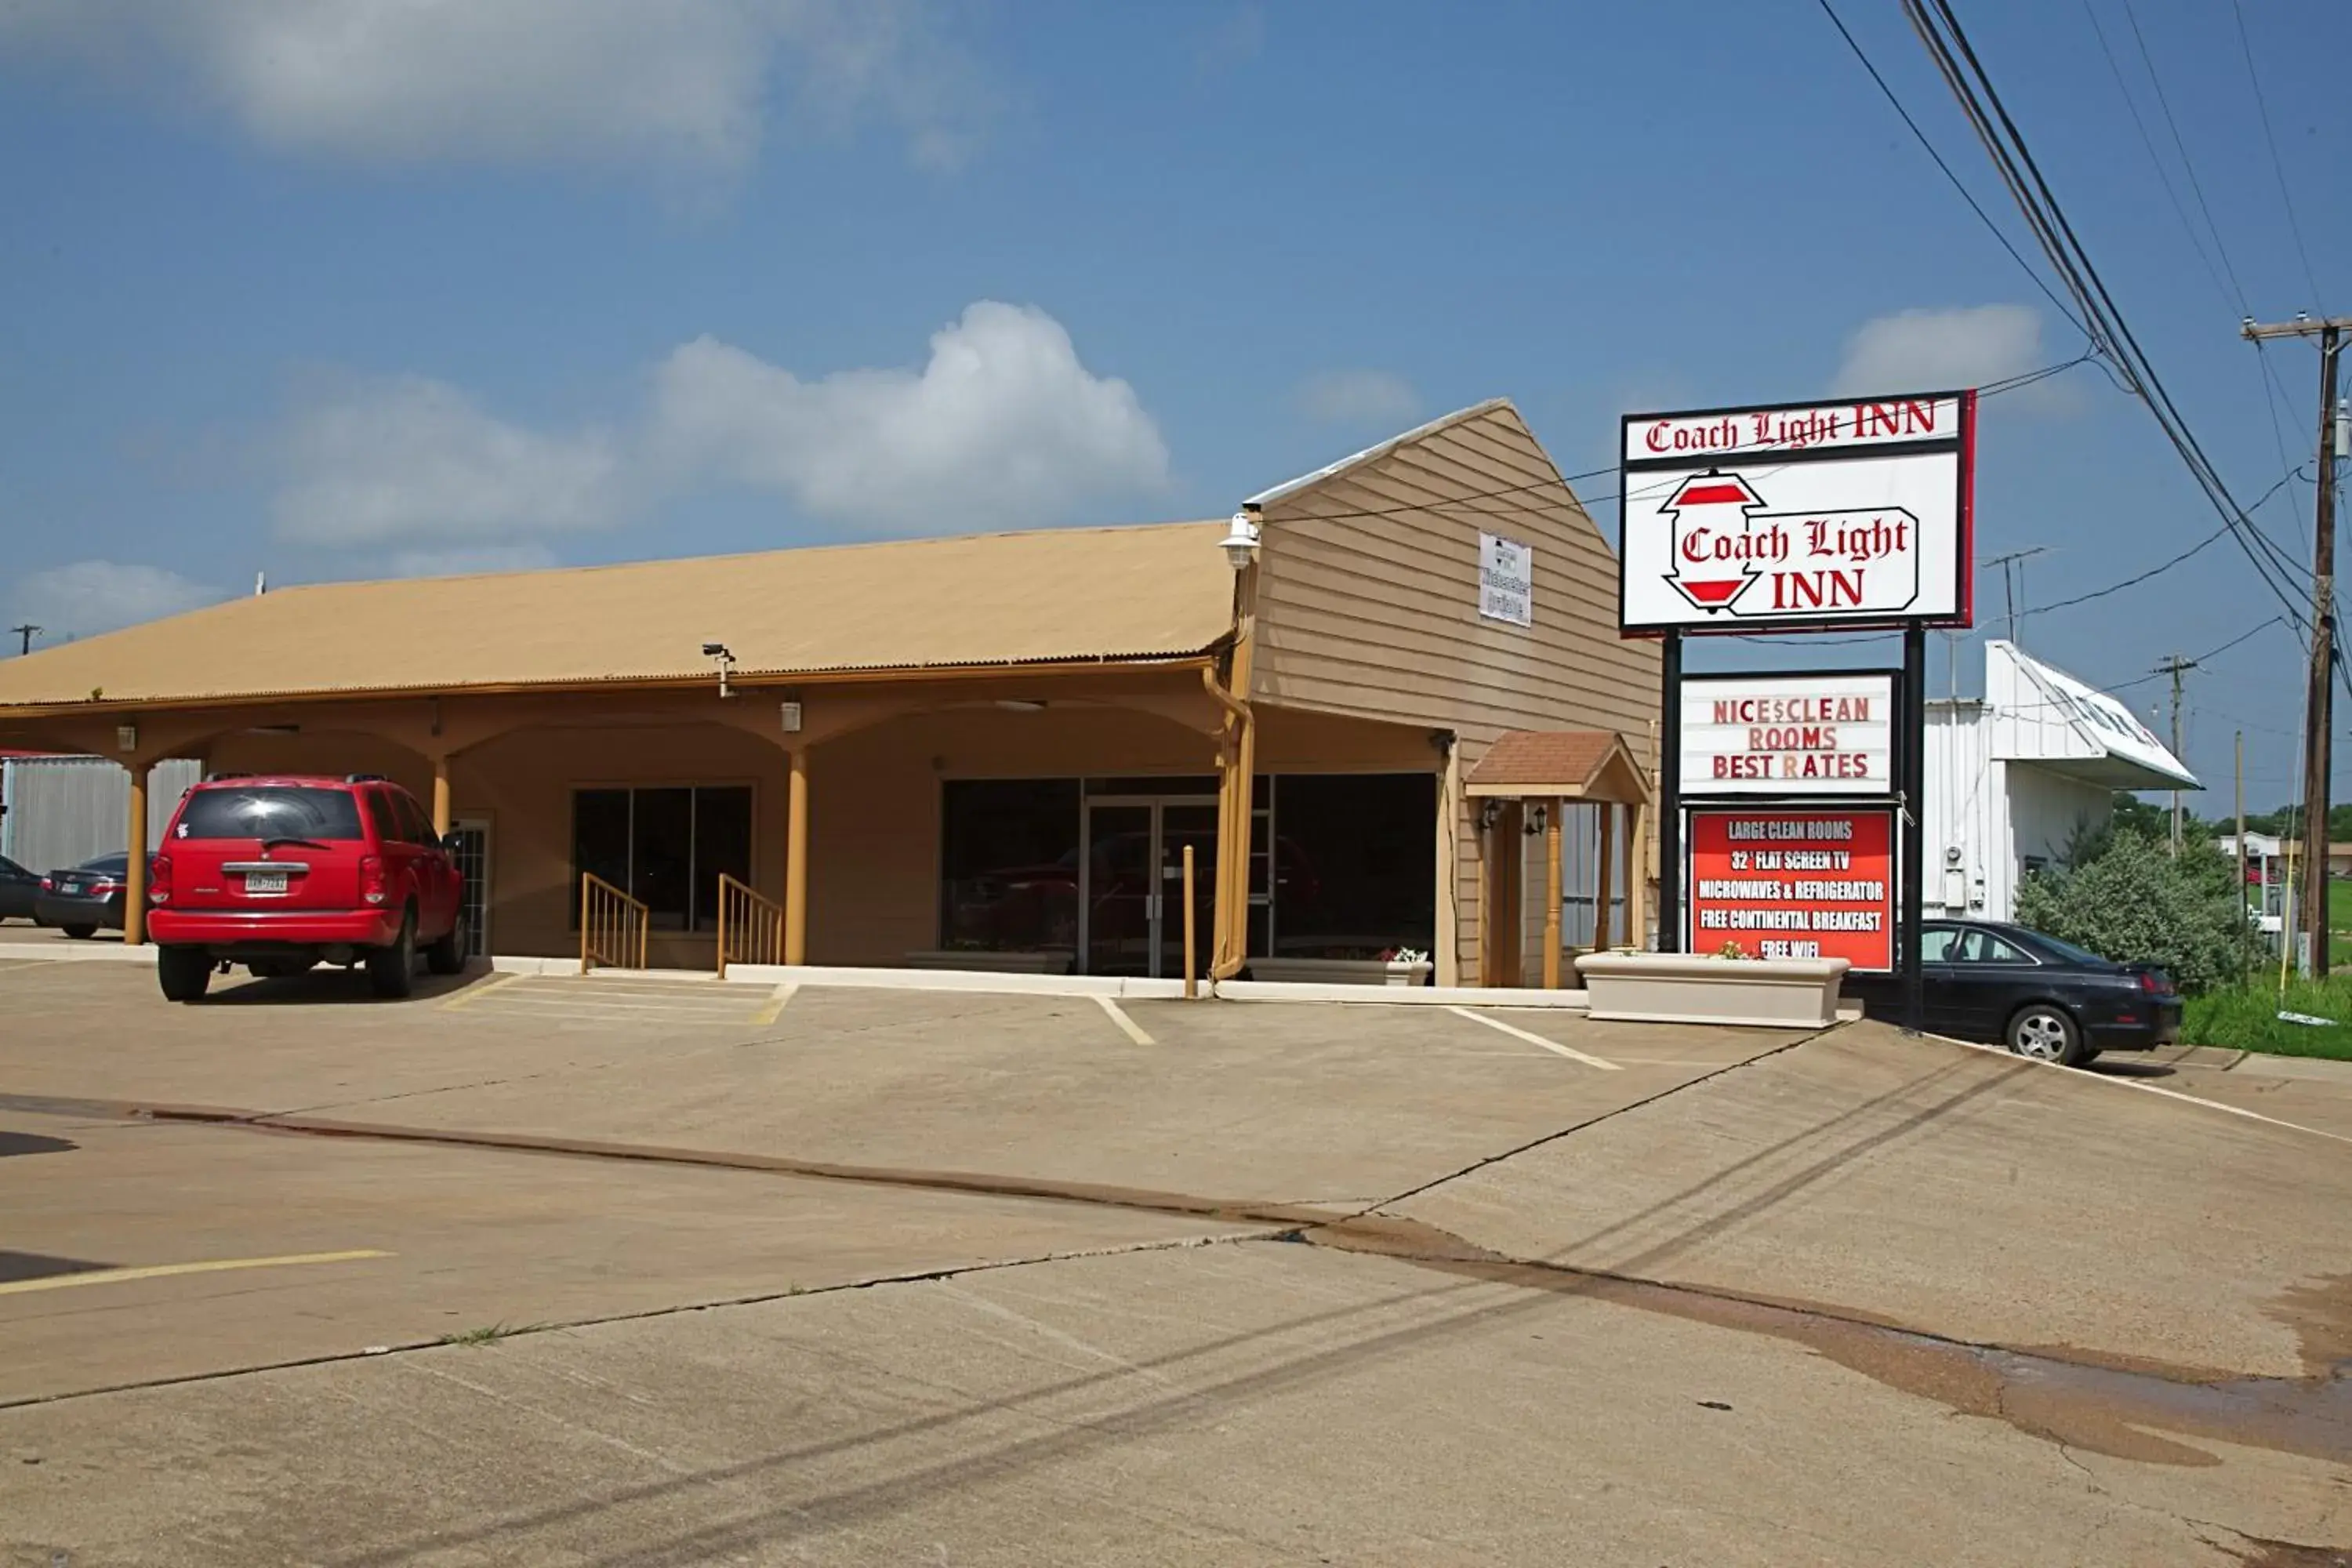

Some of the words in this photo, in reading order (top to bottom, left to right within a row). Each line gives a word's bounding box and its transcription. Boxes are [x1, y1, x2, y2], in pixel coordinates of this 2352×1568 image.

[1646, 415, 1739, 452] Coach
[1751, 408, 1840, 449] Light
[1853, 400, 1936, 438] INN
[1682, 524, 1789, 563] Coach
[1803, 518, 1909, 563] Light
[1771, 568, 1865, 609] INN
[1749, 726, 1838, 751] ROOMS
[1713, 754, 1774, 779] BEST
[1782, 753, 1868, 779] RATES
[1729, 821, 1766, 840] LARGE
[1768, 821, 1804, 840] CLEAN
[1807, 821, 1853, 840] ROOMS
[1755, 851, 1782, 869] FLAT
[1784, 851, 1831, 869] SCREEN
[1833, 851, 1849, 869] TV
[1699, 880, 1781, 899] MICROWAVES
[1784, 884, 1793, 899] &
[1795, 880, 1883, 901] REFRIGERATOR
[1700, 909, 1727, 928] FREE
[1730, 910, 1810, 929] CONTINENTAL
[1812, 911, 1882, 931] BREAKFAST
[1761, 940, 1788, 957] FREE
